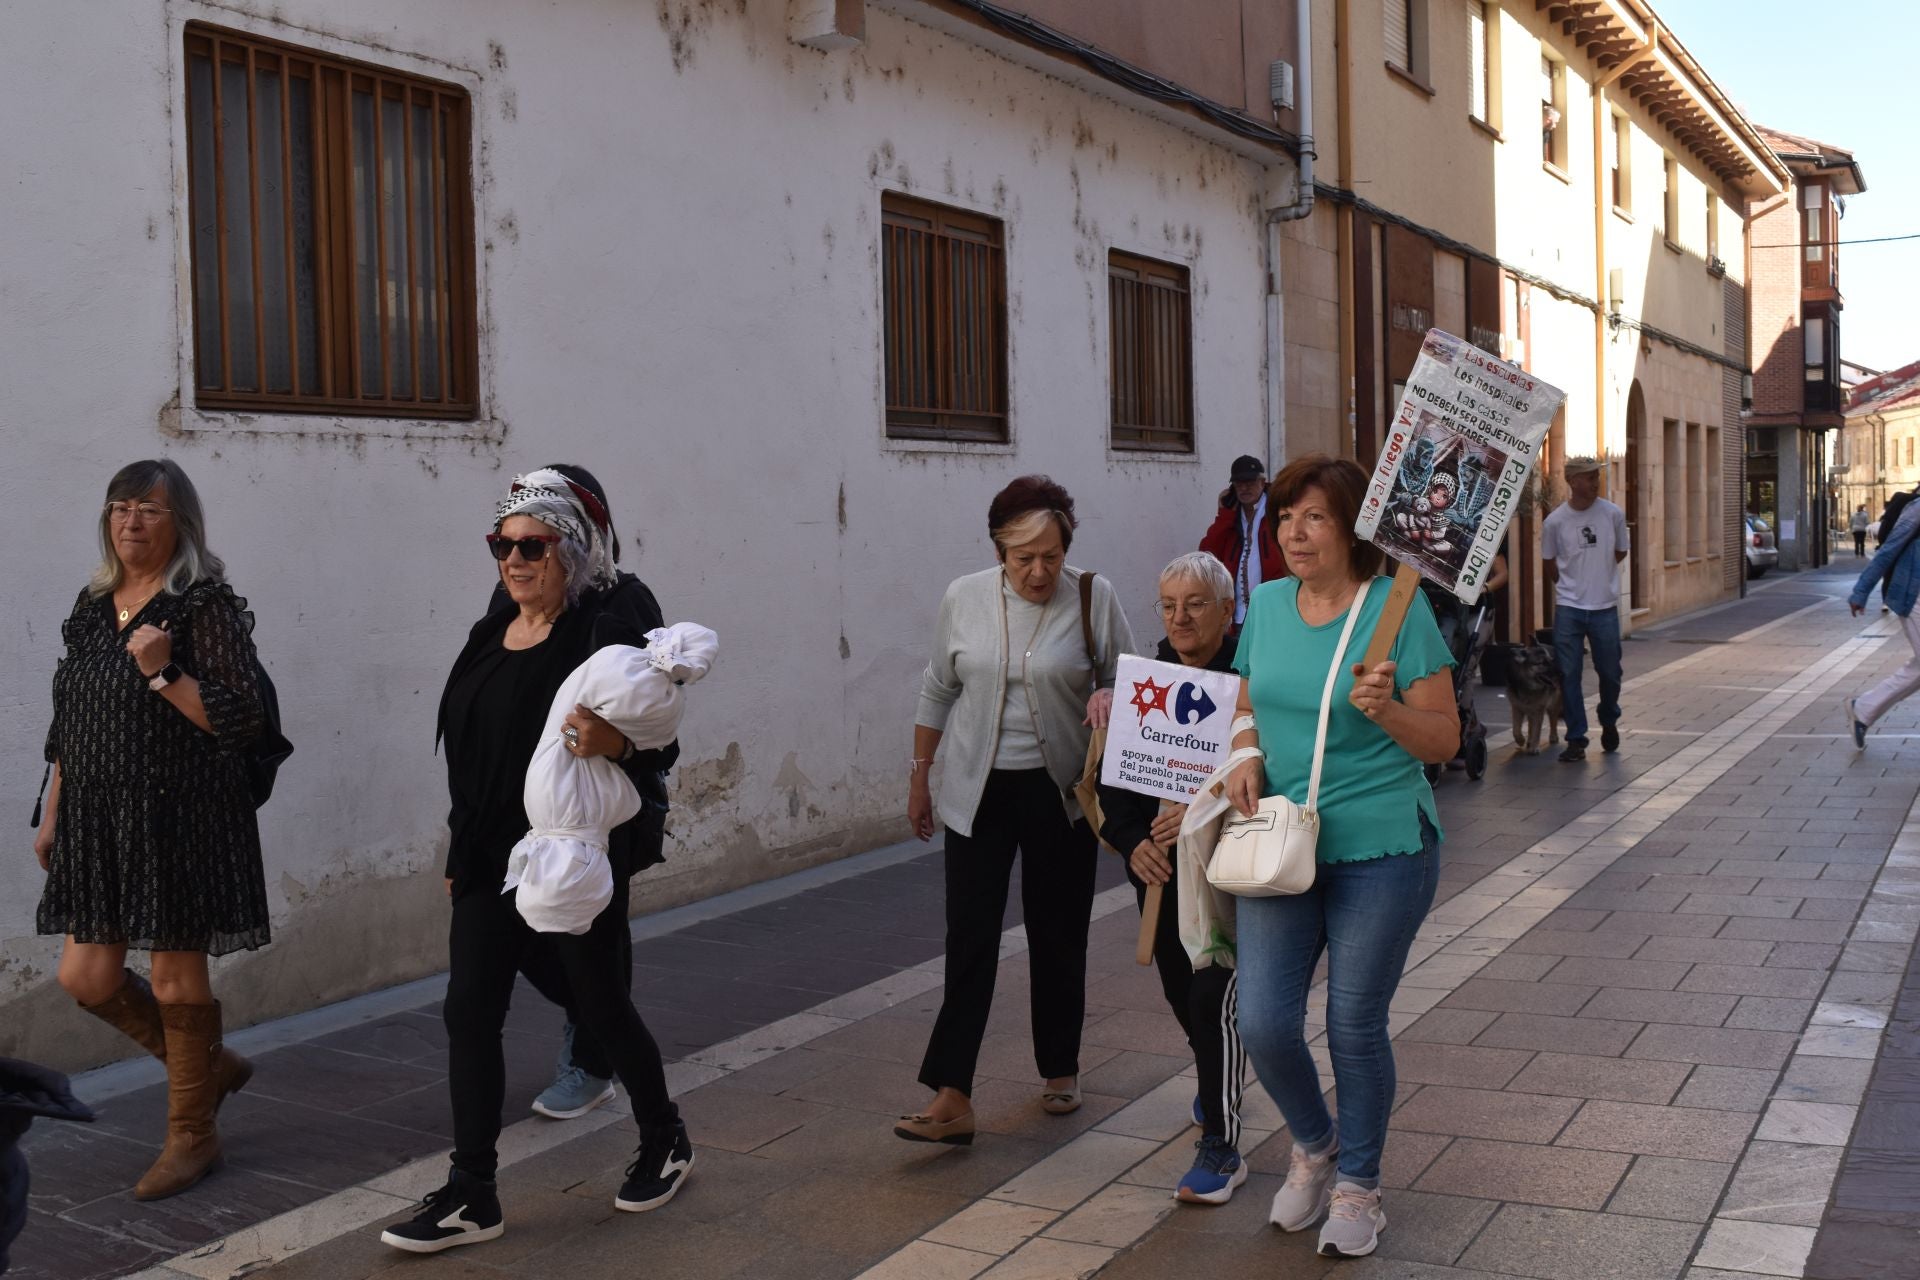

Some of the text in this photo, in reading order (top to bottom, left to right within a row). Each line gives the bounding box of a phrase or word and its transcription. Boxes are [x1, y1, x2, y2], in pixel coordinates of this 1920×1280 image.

[1465, 349, 1534, 392] Las escuelas
[1454, 366, 1530, 413] Los hospitales
[1412, 384, 1532, 455] NO DEBEN SER OBJETIVOS
[1456, 390, 1511, 426] Las casas
[1440, 415, 1490, 448] MILITARES
[1362, 400, 1417, 524] Alto al fuego, ya!
[1461, 458, 1526, 587] Palestina libre
[1121, 749, 1153, 763] apoya
[1155, 756, 1165, 765] el
[1141, 726, 1220, 753] Carrefour
[1118, 771, 1164, 789] Pasemos
[1166, 782, 1174, 790] a
[1176, 783, 1186, 793] la
[1120, 759, 1205, 784] del pueblo pales
